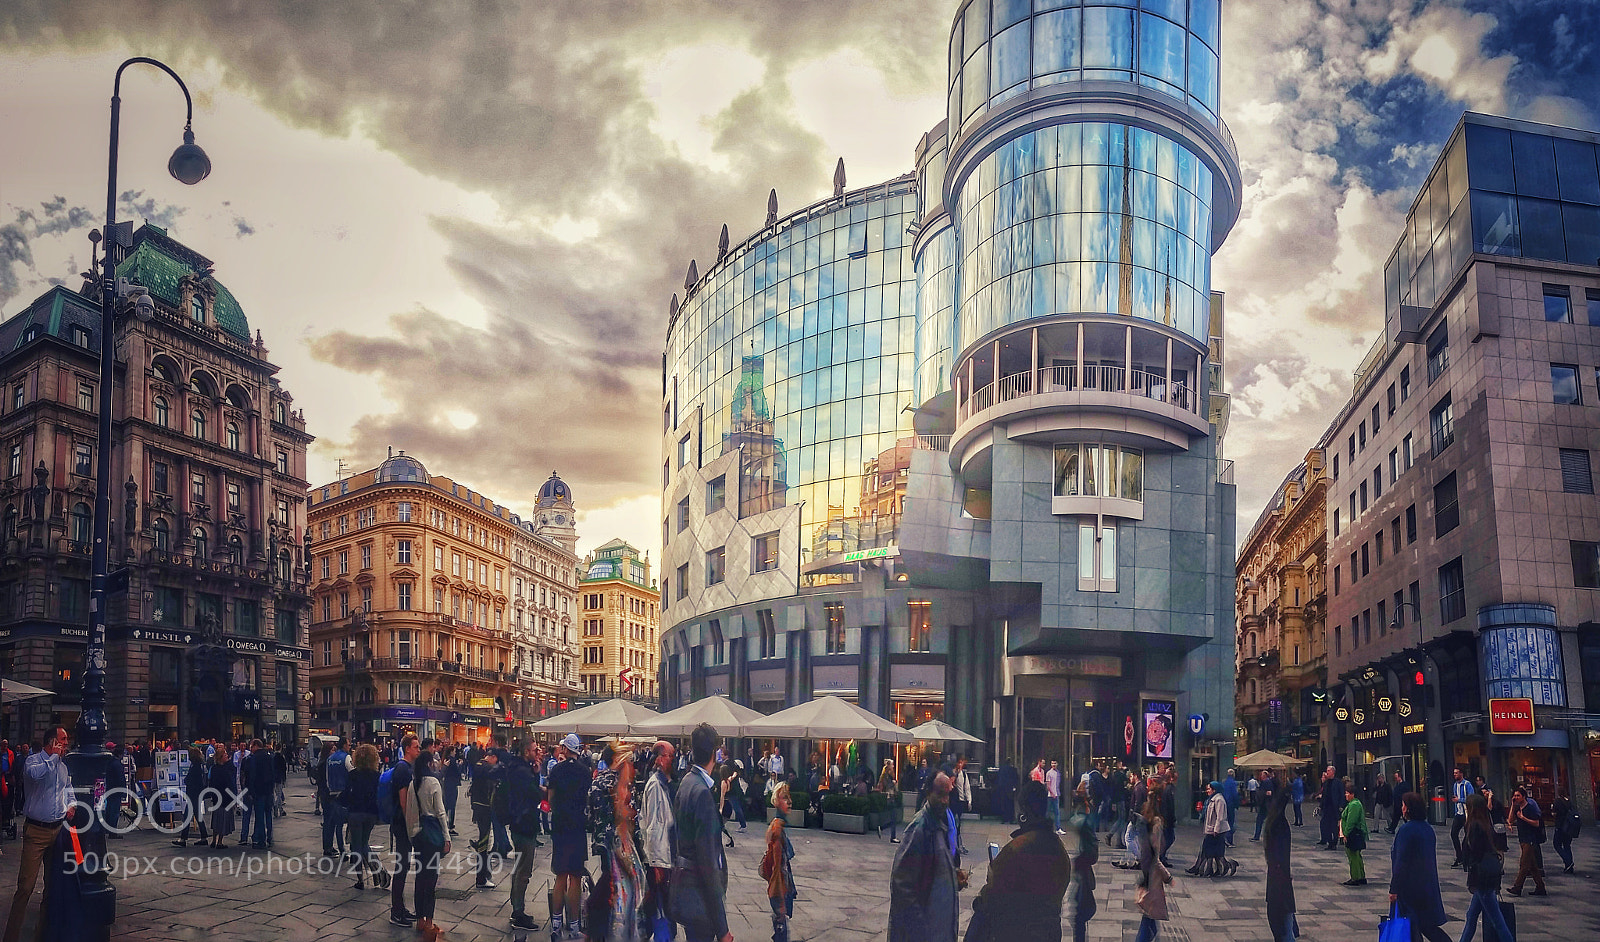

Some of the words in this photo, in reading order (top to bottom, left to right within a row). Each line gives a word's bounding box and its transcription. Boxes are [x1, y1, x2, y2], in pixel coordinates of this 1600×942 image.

[145, 631, 181, 641] PILSTL
[235, 641, 259, 650] OMEGA
[1190, 718, 1203, 733] U
